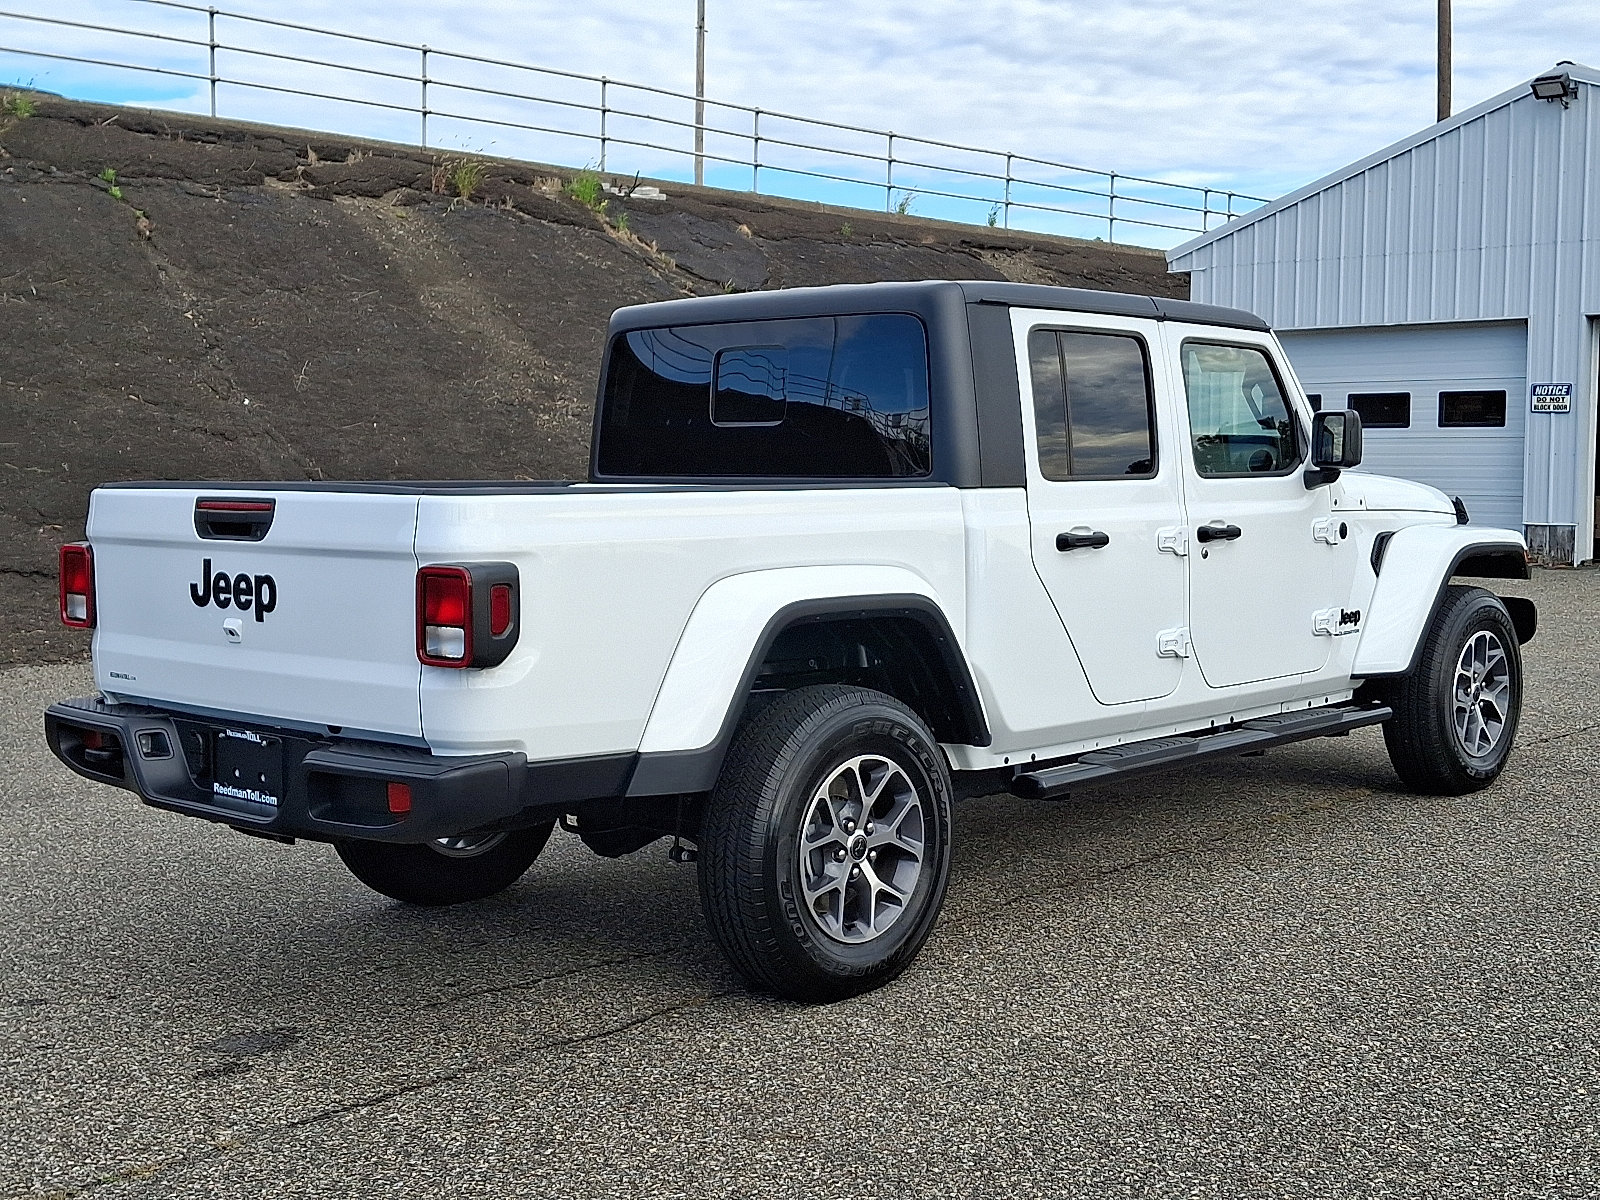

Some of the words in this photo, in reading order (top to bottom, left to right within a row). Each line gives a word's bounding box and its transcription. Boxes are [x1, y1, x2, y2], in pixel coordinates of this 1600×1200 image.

[1535, 386, 1568, 395] NOTICE
[190, 558, 277, 622] Jeep
[1338, 608, 1361, 627] Jeep
[213, 782, 278, 806] ReedmanToll.com
